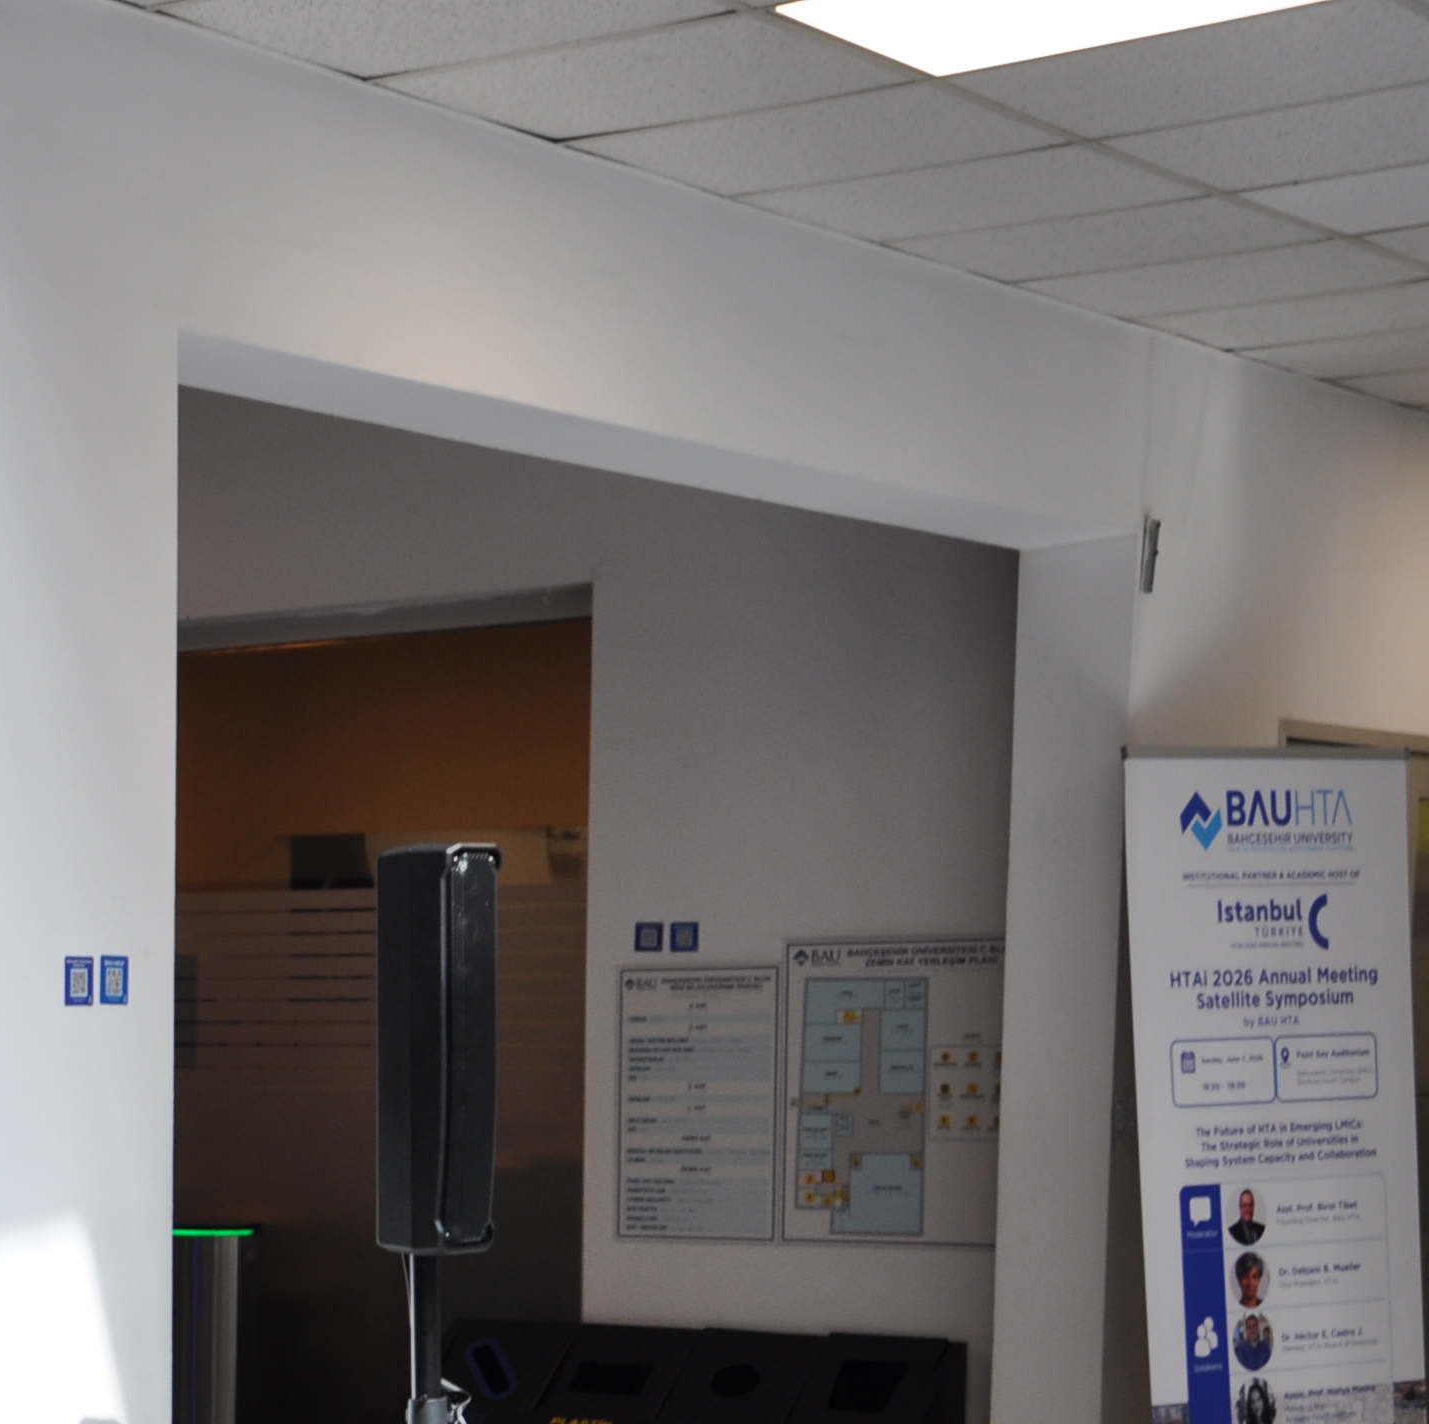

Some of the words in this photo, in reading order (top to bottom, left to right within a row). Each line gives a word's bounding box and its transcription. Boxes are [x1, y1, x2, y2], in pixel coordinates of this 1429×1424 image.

[1293, 832, 1353, 845] UNIVERSITY
[1170, 971, 1207, 988] HTAi
[1213, 969, 1253, 987] 2026
[1259, 967, 1311, 985] Annual
[1317, 965, 1378, 985] Meeting
[1197, 991, 1260, 1009] Satellite
[1266, 989, 1354, 1010] Symposium
[1258, 1016, 1278, 1026] BAU
[1281, 1015, 1299, 1025] HTA
[1196, 1126, 1211, 1137] The
[1213, 1125, 1243, 1136] Future
[1247, 1124, 1256, 1134] of
[1258, 1123, 1276, 1133] HTA
[1279, 1122, 1288, 1132] in
[1290, 1120, 1333, 1133] Emerging
[1201, 1141, 1217, 1152] The
[1220, 1139, 1261, 1152] Strategic
[1263, 1138, 1283, 1148] Role
[1286, 1137, 1295, 1147] of
[1297, 1135, 1348, 1147] Universities
[1350, 1134, 1359, 1144] in
[1185, 1157, 1220, 1169] Shaping
[1222, 1155, 1256, 1168] System
[1258, 1152, 1296, 1165] Capacity
[1298, 1151, 1314, 1161] and
[1317, 1148, 1377, 1160] Collaboration
